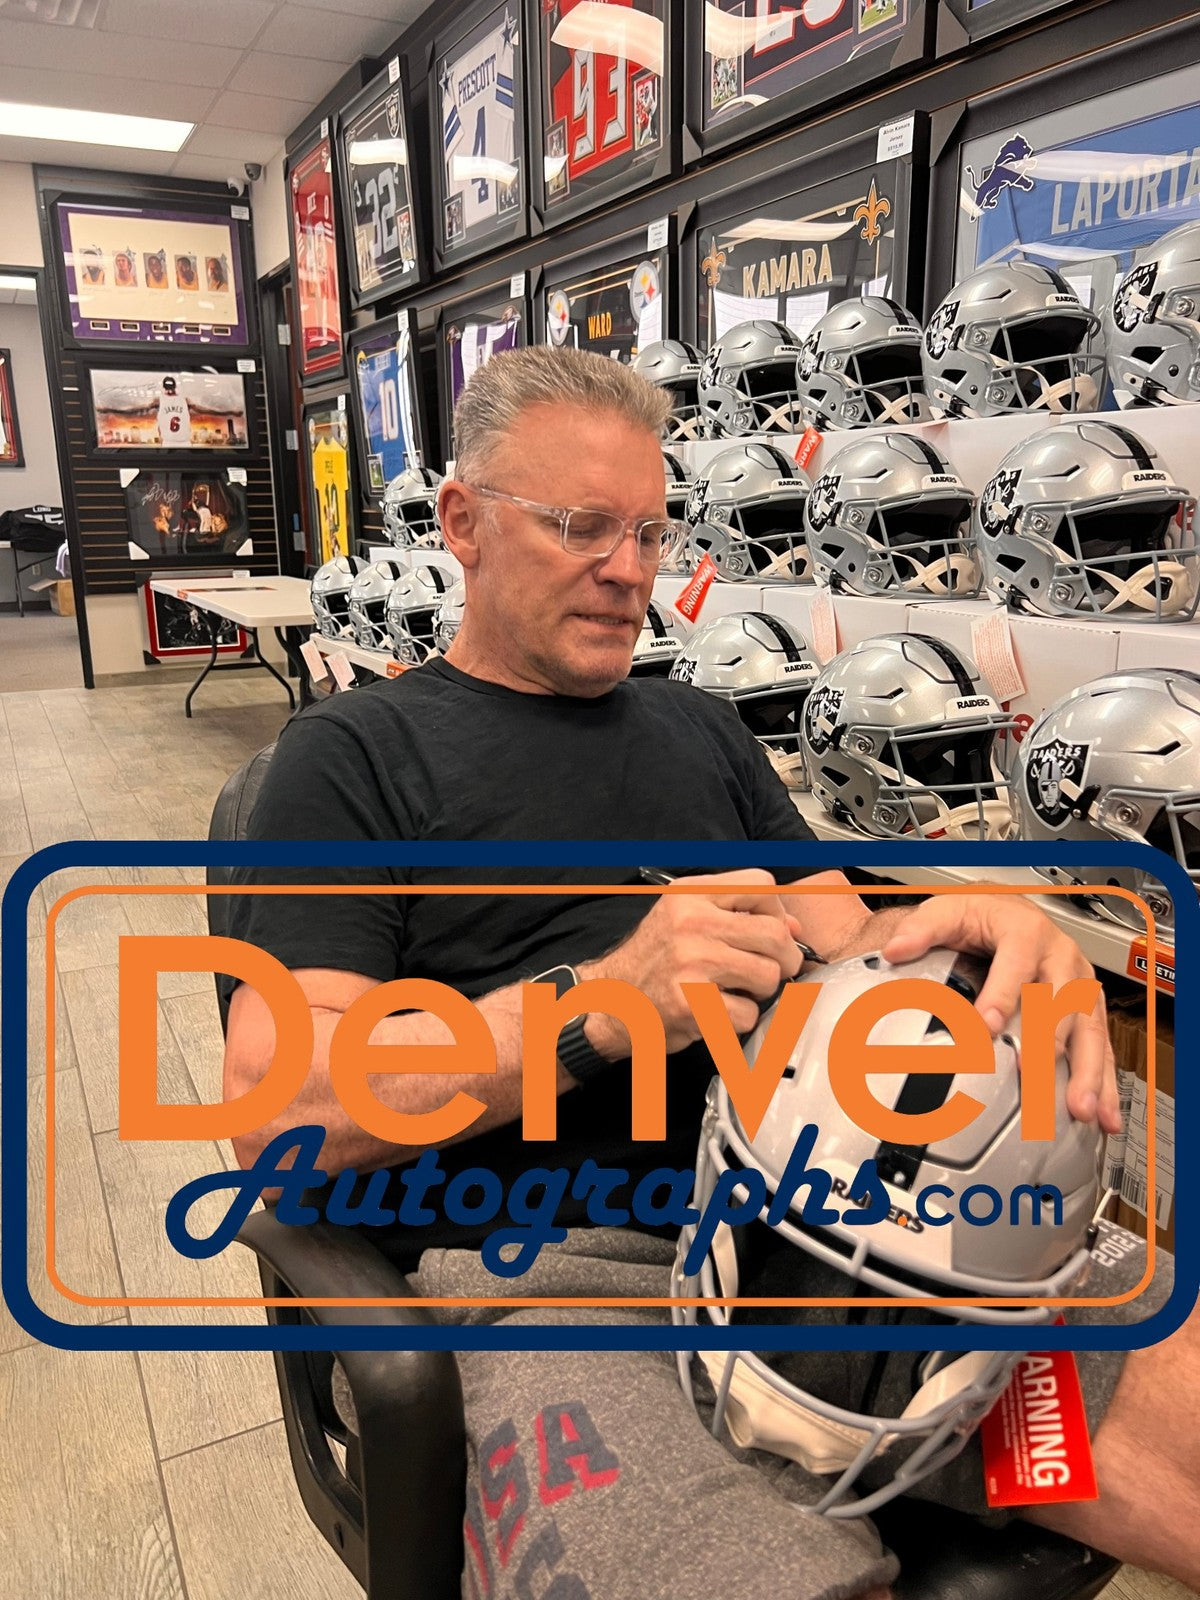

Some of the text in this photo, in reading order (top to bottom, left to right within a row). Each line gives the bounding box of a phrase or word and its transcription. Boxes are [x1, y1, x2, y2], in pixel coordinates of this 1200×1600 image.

[458, 53, 496, 107] PRESCOTT
[471, 106, 489, 204] 4
[1051, 146, 1200, 235] LAPORTA
[365, 167, 399, 260] 32
[742, 243, 833, 298] KAMARA
[587, 311, 612, 340] WARD
[164, 405, 183, 414] JAMES
[169, 416, 181, 432] 6
[379, 378, 398, 442] 10
[930, 476, 957, 484] RAIDERS
[1133, 473, 1166, 482] RAIDERS
[683, 564, 713, 615] WARNING
[650, 640, 677, 648] RAIDERS
[784, 663, 813, 673] RAIDERS
[957, 698, 990, 709] RAIDERS
[1090, 1234, 1137, 1268] 2012
[1021, 1354, 1071, 1488] ARNING
